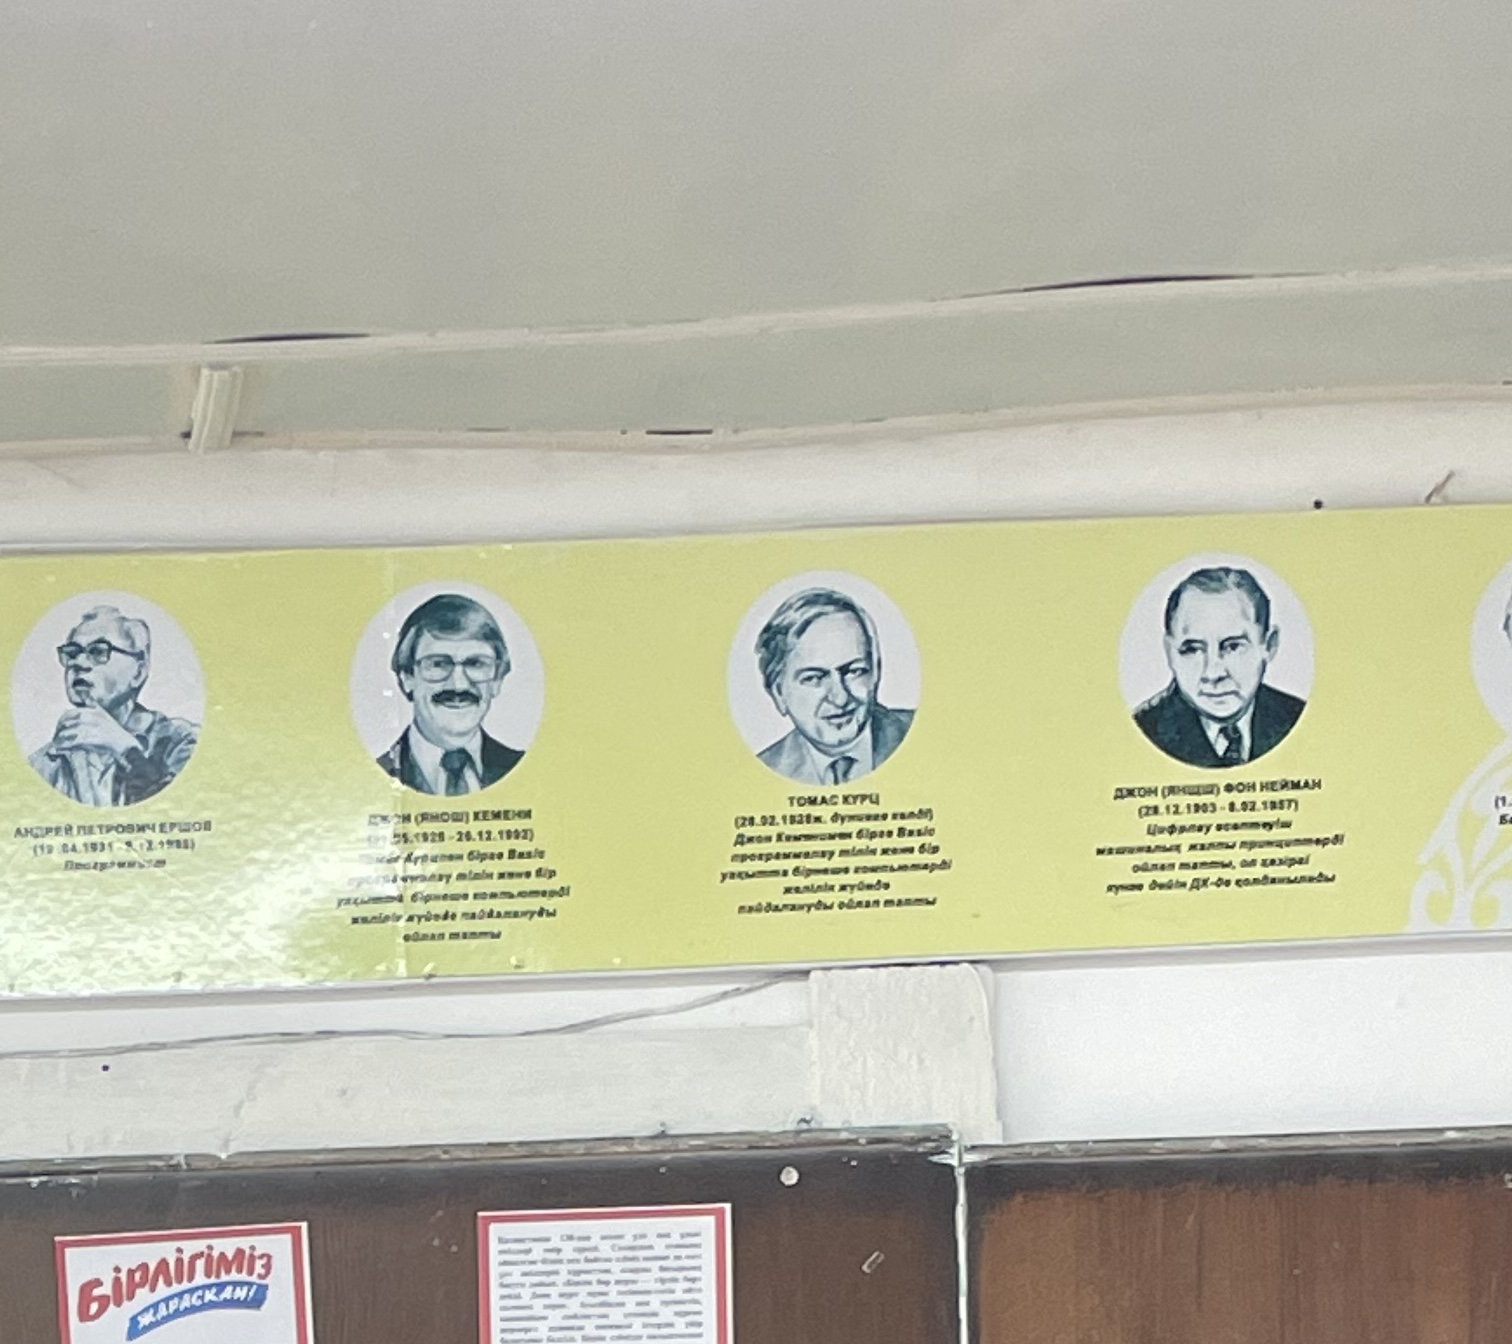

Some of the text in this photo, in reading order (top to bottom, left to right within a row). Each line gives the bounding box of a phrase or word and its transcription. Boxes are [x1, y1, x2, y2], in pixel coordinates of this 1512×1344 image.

[1113, 786, 1158, 801] ДЖОН
[1223, 782, 1257, 793] ФОН
[1259, 778, 1322, 792] НЕЙМАН
[787, 793, 881, 808] ТОМАС КУРЦ
[414, 811, 470, 827] (ЯНОШ)
[14, 820, 212, 838] АНДРЕЙ ПЕТРОВИЧ ЕРШОВ
[733, 832, 772, 847] Джон
